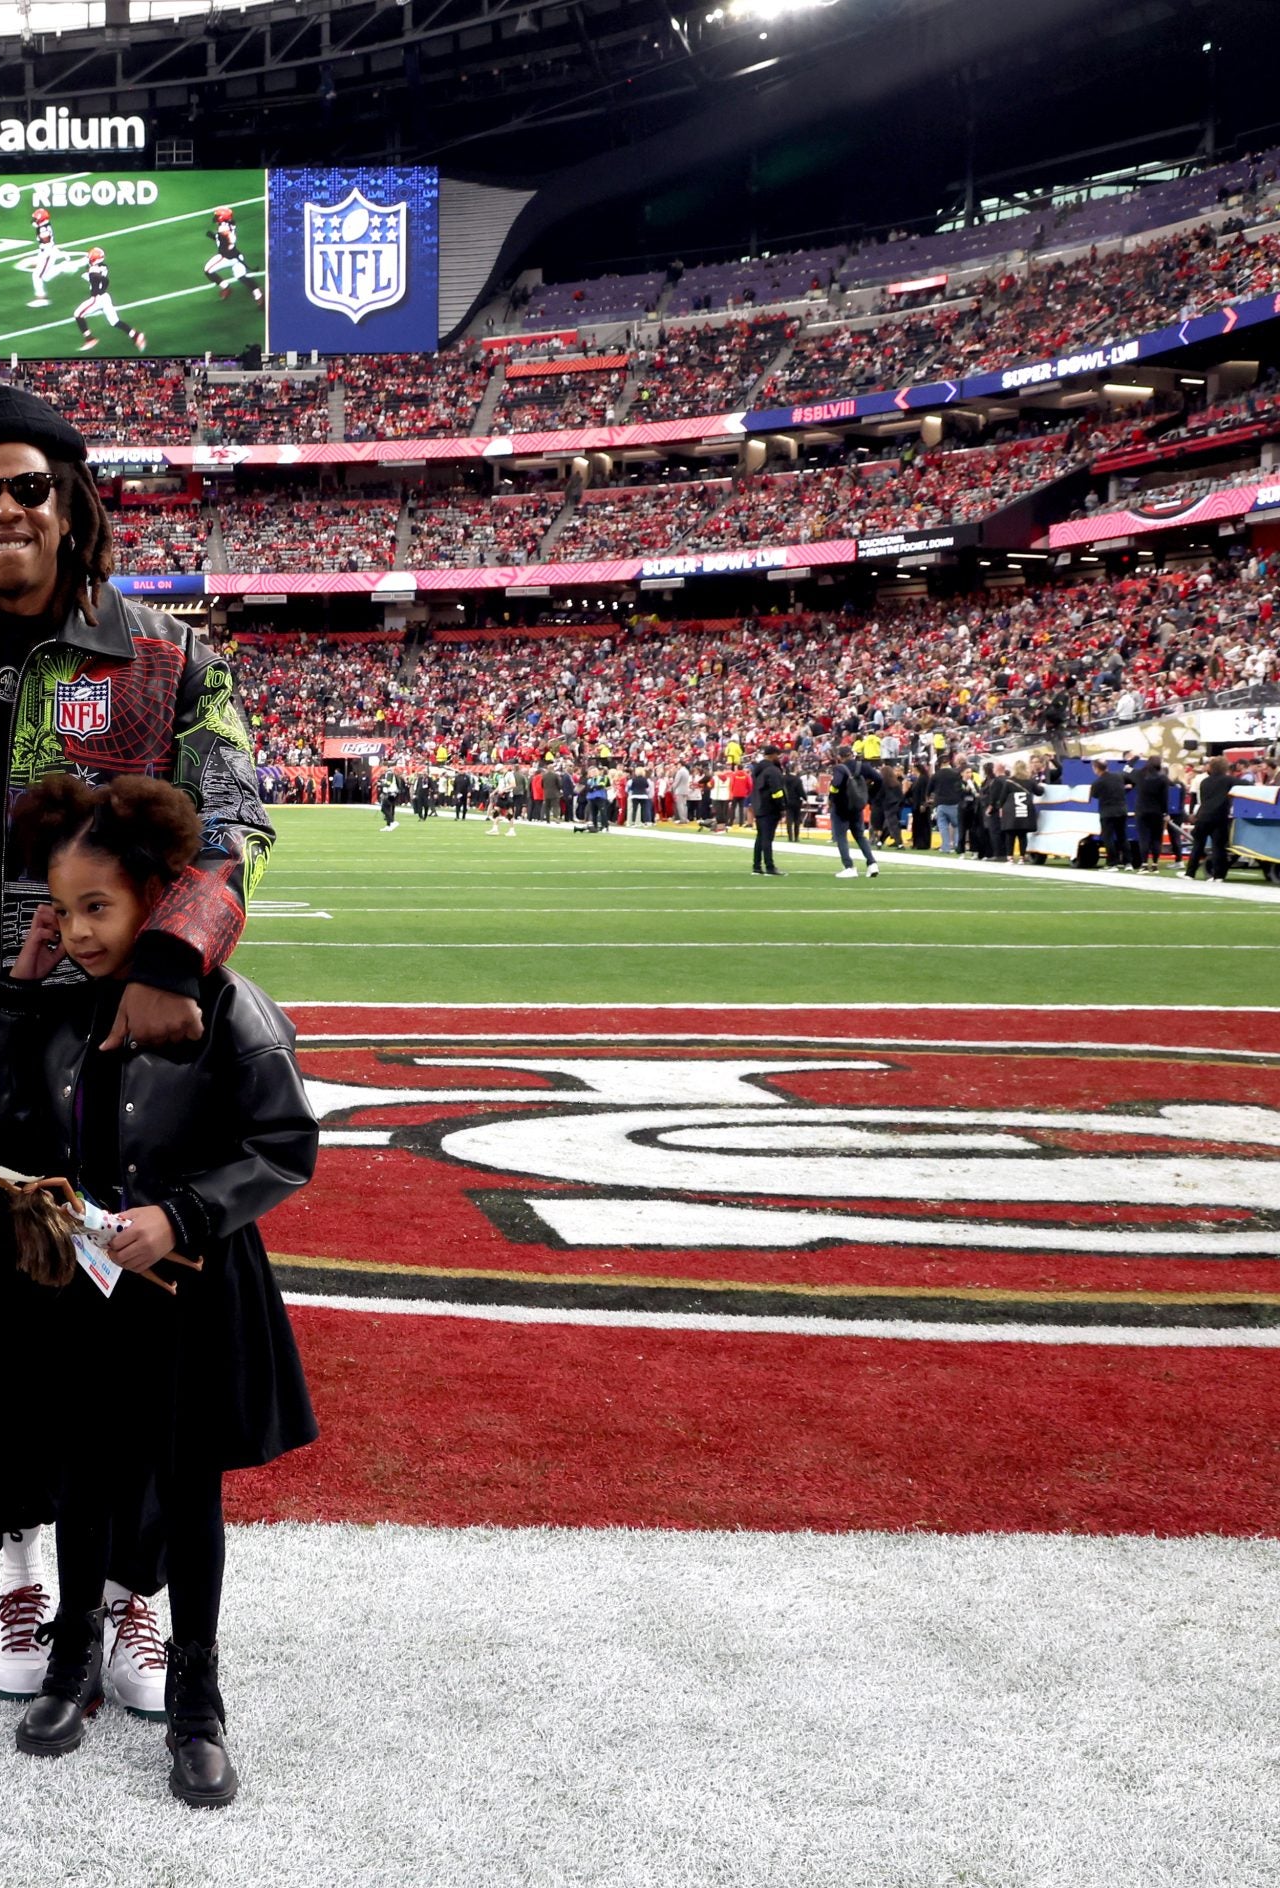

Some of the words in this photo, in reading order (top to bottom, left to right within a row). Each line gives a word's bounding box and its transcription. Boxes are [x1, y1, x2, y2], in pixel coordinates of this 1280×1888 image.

[32, 180, 158, 209] RECORD
[320, 250, 391, 300] NFL
[792, 400, 855, 423] #SBLVIII
[133, 581, 155, 589] BALL
[157, 580, 172, 589] ON
[60, 702, 105, 732] NFL
